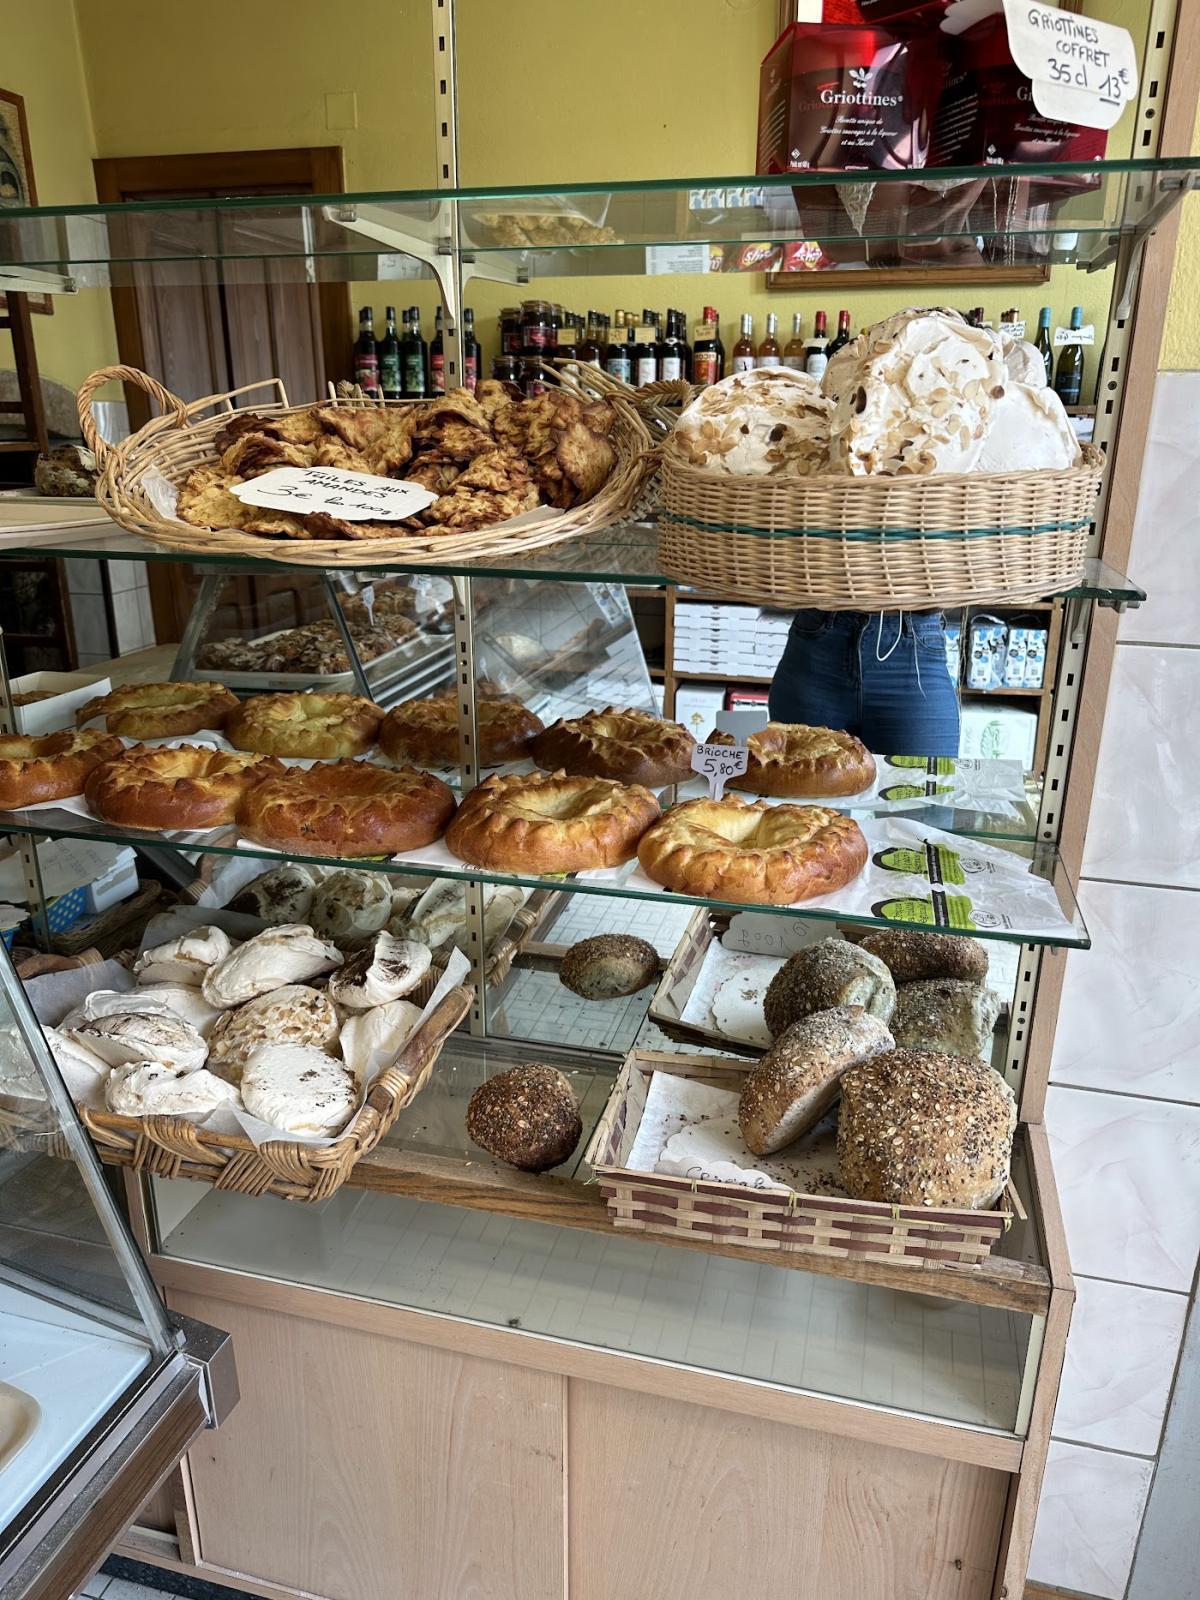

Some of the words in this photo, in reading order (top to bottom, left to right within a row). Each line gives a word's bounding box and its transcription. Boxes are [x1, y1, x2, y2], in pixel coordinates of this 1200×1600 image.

[1055, 39, 1111, 68] COFFRET
[820, 89, 898, 107] Griottines
[299, 479, 388, 499] AMANDES
[374, 486, 409, 495] AUX
[703, 758, 744, 777] 5,80€
